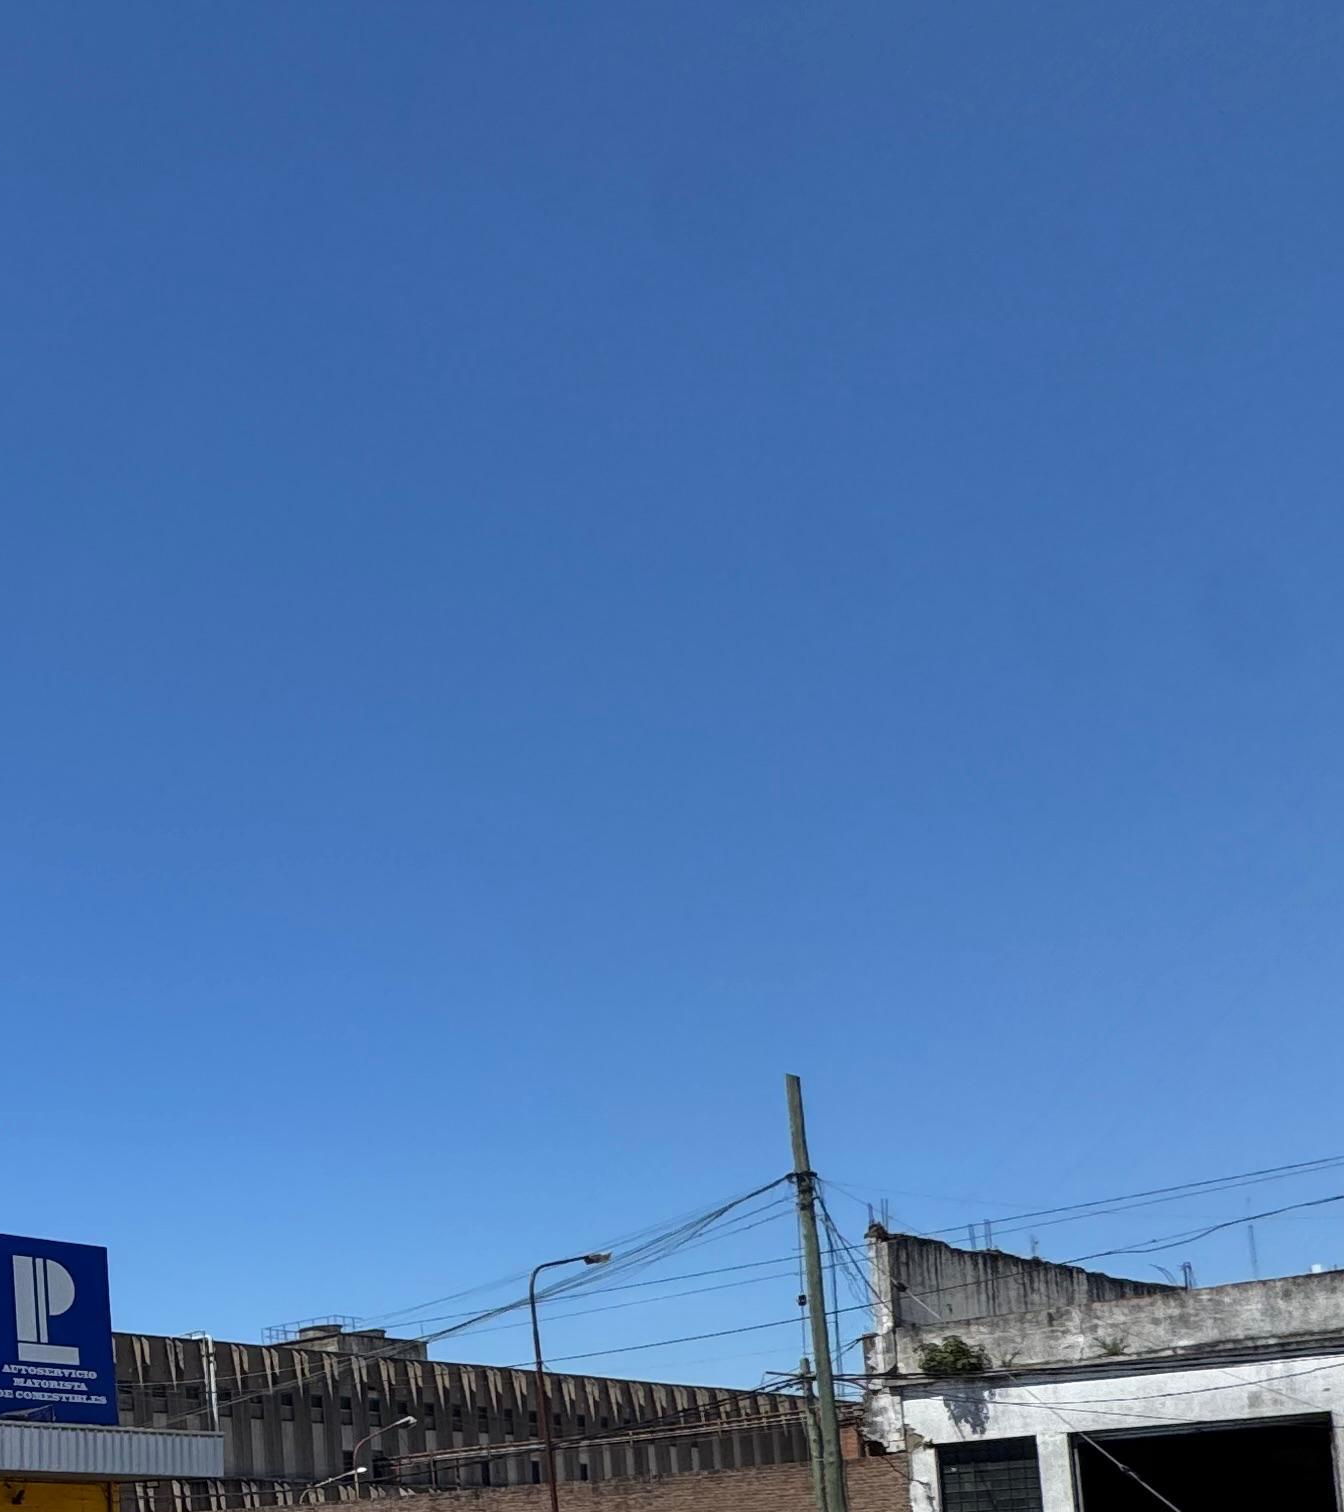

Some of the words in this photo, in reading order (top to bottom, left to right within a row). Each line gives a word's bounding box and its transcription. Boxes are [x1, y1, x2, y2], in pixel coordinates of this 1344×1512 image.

[2, 1364, 97, 1379] AUTOSERVICIO
[13, 1378, 88, 1391] MAYORISTA
[15, 1391, 107, 1404] COMESTIBLES
